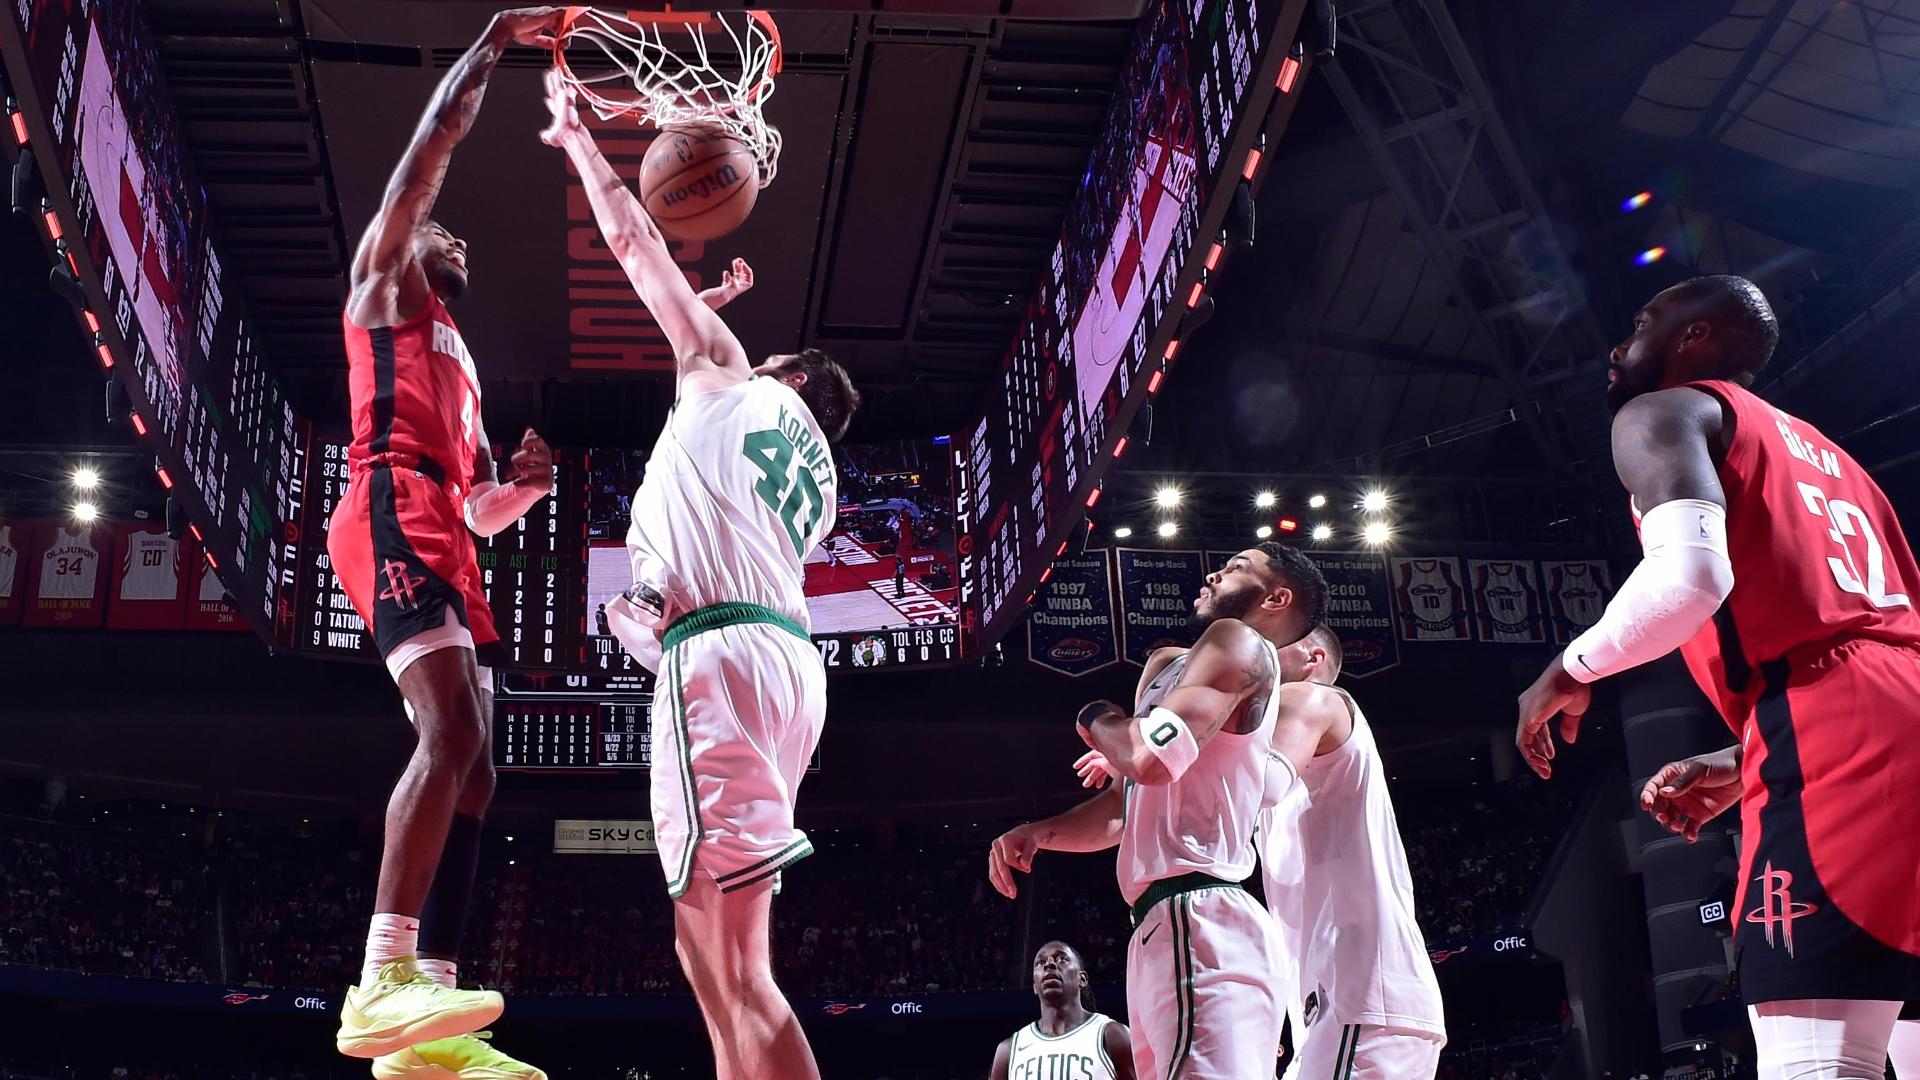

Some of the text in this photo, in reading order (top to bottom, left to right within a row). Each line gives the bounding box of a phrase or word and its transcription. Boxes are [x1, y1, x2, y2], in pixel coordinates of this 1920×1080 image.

[662, 164, 741, 207] Wilson
[324, 444, 338, 459] 28
[778, 404, 834, 486] KORNET
[323, 462, 337, 477] 32
[324, 480, 332, 495] 5
[743, 429, 824, 558] 40
[323, 498, 331, 513] 9
[549, 500, 557, 515] 3
[321, 517, 328, 532] 4
[518, 517, 557, 533] 0 3
[518, 535, 524, 550] 1
[549, 536, 555, 551] 1
[1796, 481, 1911, 611] 32
[46, 546, 97, 560] OLAJUWON
[56, 557, 82, 576] 34
[315, 554, 329, 569] 40
[479, 552, 557, 571] REB AST FLS
[1072, 560, 1100, 568] Season
[1133, 558, 1188, 569] Back-to-Back
[1343, 561, 1382, 570] Champs
[317, 572, 325, 588] 8
[484, 569, 555, 588] 6 1 2
[1051, 583, 1086, 595] 1997
[1145, 584, 1180, 596] 1998
[1330, 584, 1366, 596] 2000
[316, 592, 323, 607] 4
[515, 590, 523, 605] 2
[546, 591, 554, 607] 2
[1047, 598, 1093, 610] WNBA
[1141, 598, 1186, 611] WNBA
[1328, 600, 1372, 612] WNBA
[201, 604, 218, 612] HALL
[218, 614, 234, 622] 2016
[314, 610, 365, 630] 0 TATUM
[514, 608, 554, 625] 3 0
[1034, 612, 1109, 628] Champions
[1128, 613, 1187, 628] Champio
[1327, 616, 1390, 629] hampions
[313, 630, 361, 650] 9 WHITE
[513, 627, 553, 644] 3 0
[892, 628, 954, 647] TOL FLS CC
[595, 638, 614, 655] TOL
[817, 639, 840, 667] 72
[894, 644, 951, 663] 6 0 1
[514, 646, 553, 663] 1 0
[599, 654, 631, 670] 4 2
[588, 828, 630, 841] SKY
[1704, 906, 1720, 919] CC
[1494, 936, 1526, 951] Offic
[294, 996, 326, 1010] Offic
[892, 1002, 922, 1014] Offic
